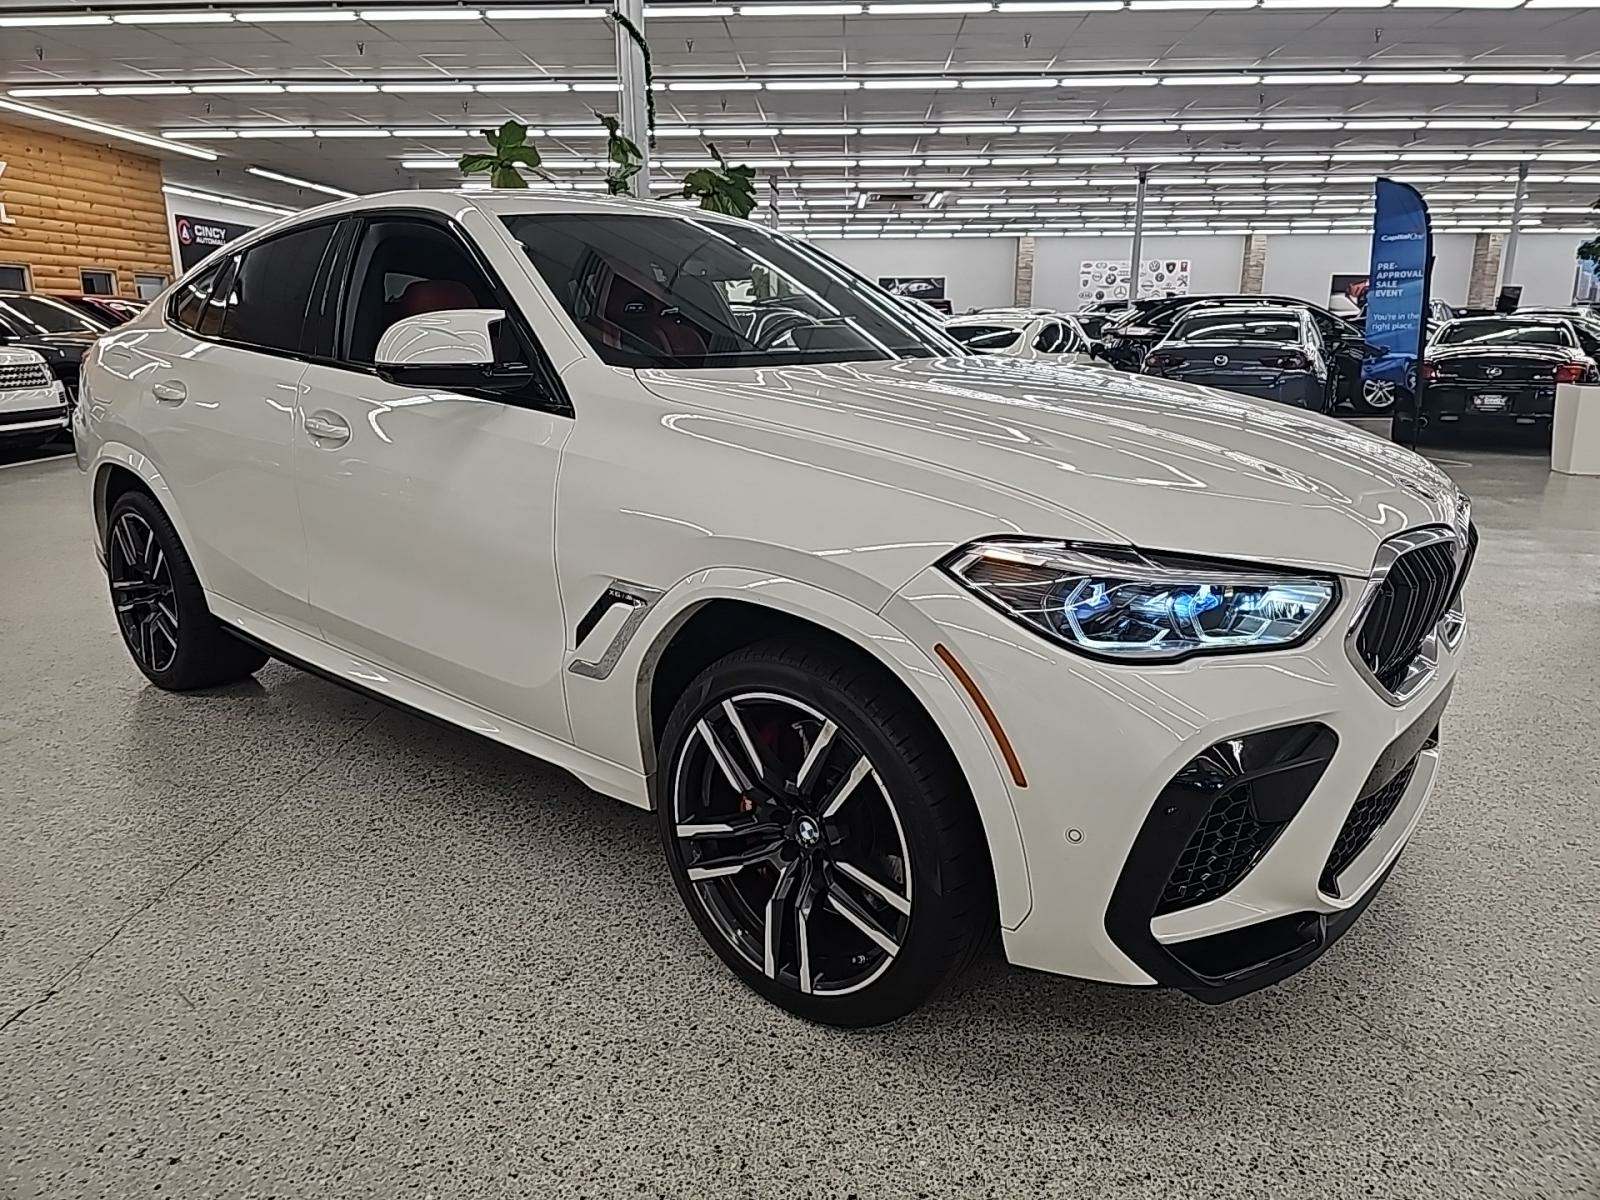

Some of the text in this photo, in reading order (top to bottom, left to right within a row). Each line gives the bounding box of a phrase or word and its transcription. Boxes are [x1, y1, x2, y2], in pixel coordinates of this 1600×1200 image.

[194, 225, 226, 240] CINCY
[1377, 262, 1398, 270] PRE-
[1376, 270, 1424, 279] APPROVAL
[1376, 280, 1398, 288] SALE
[1375, 289, 1404, 298] EVENT
[1373, 313, 1397, 321] You're
[1371, 322, 1391, 332] right
